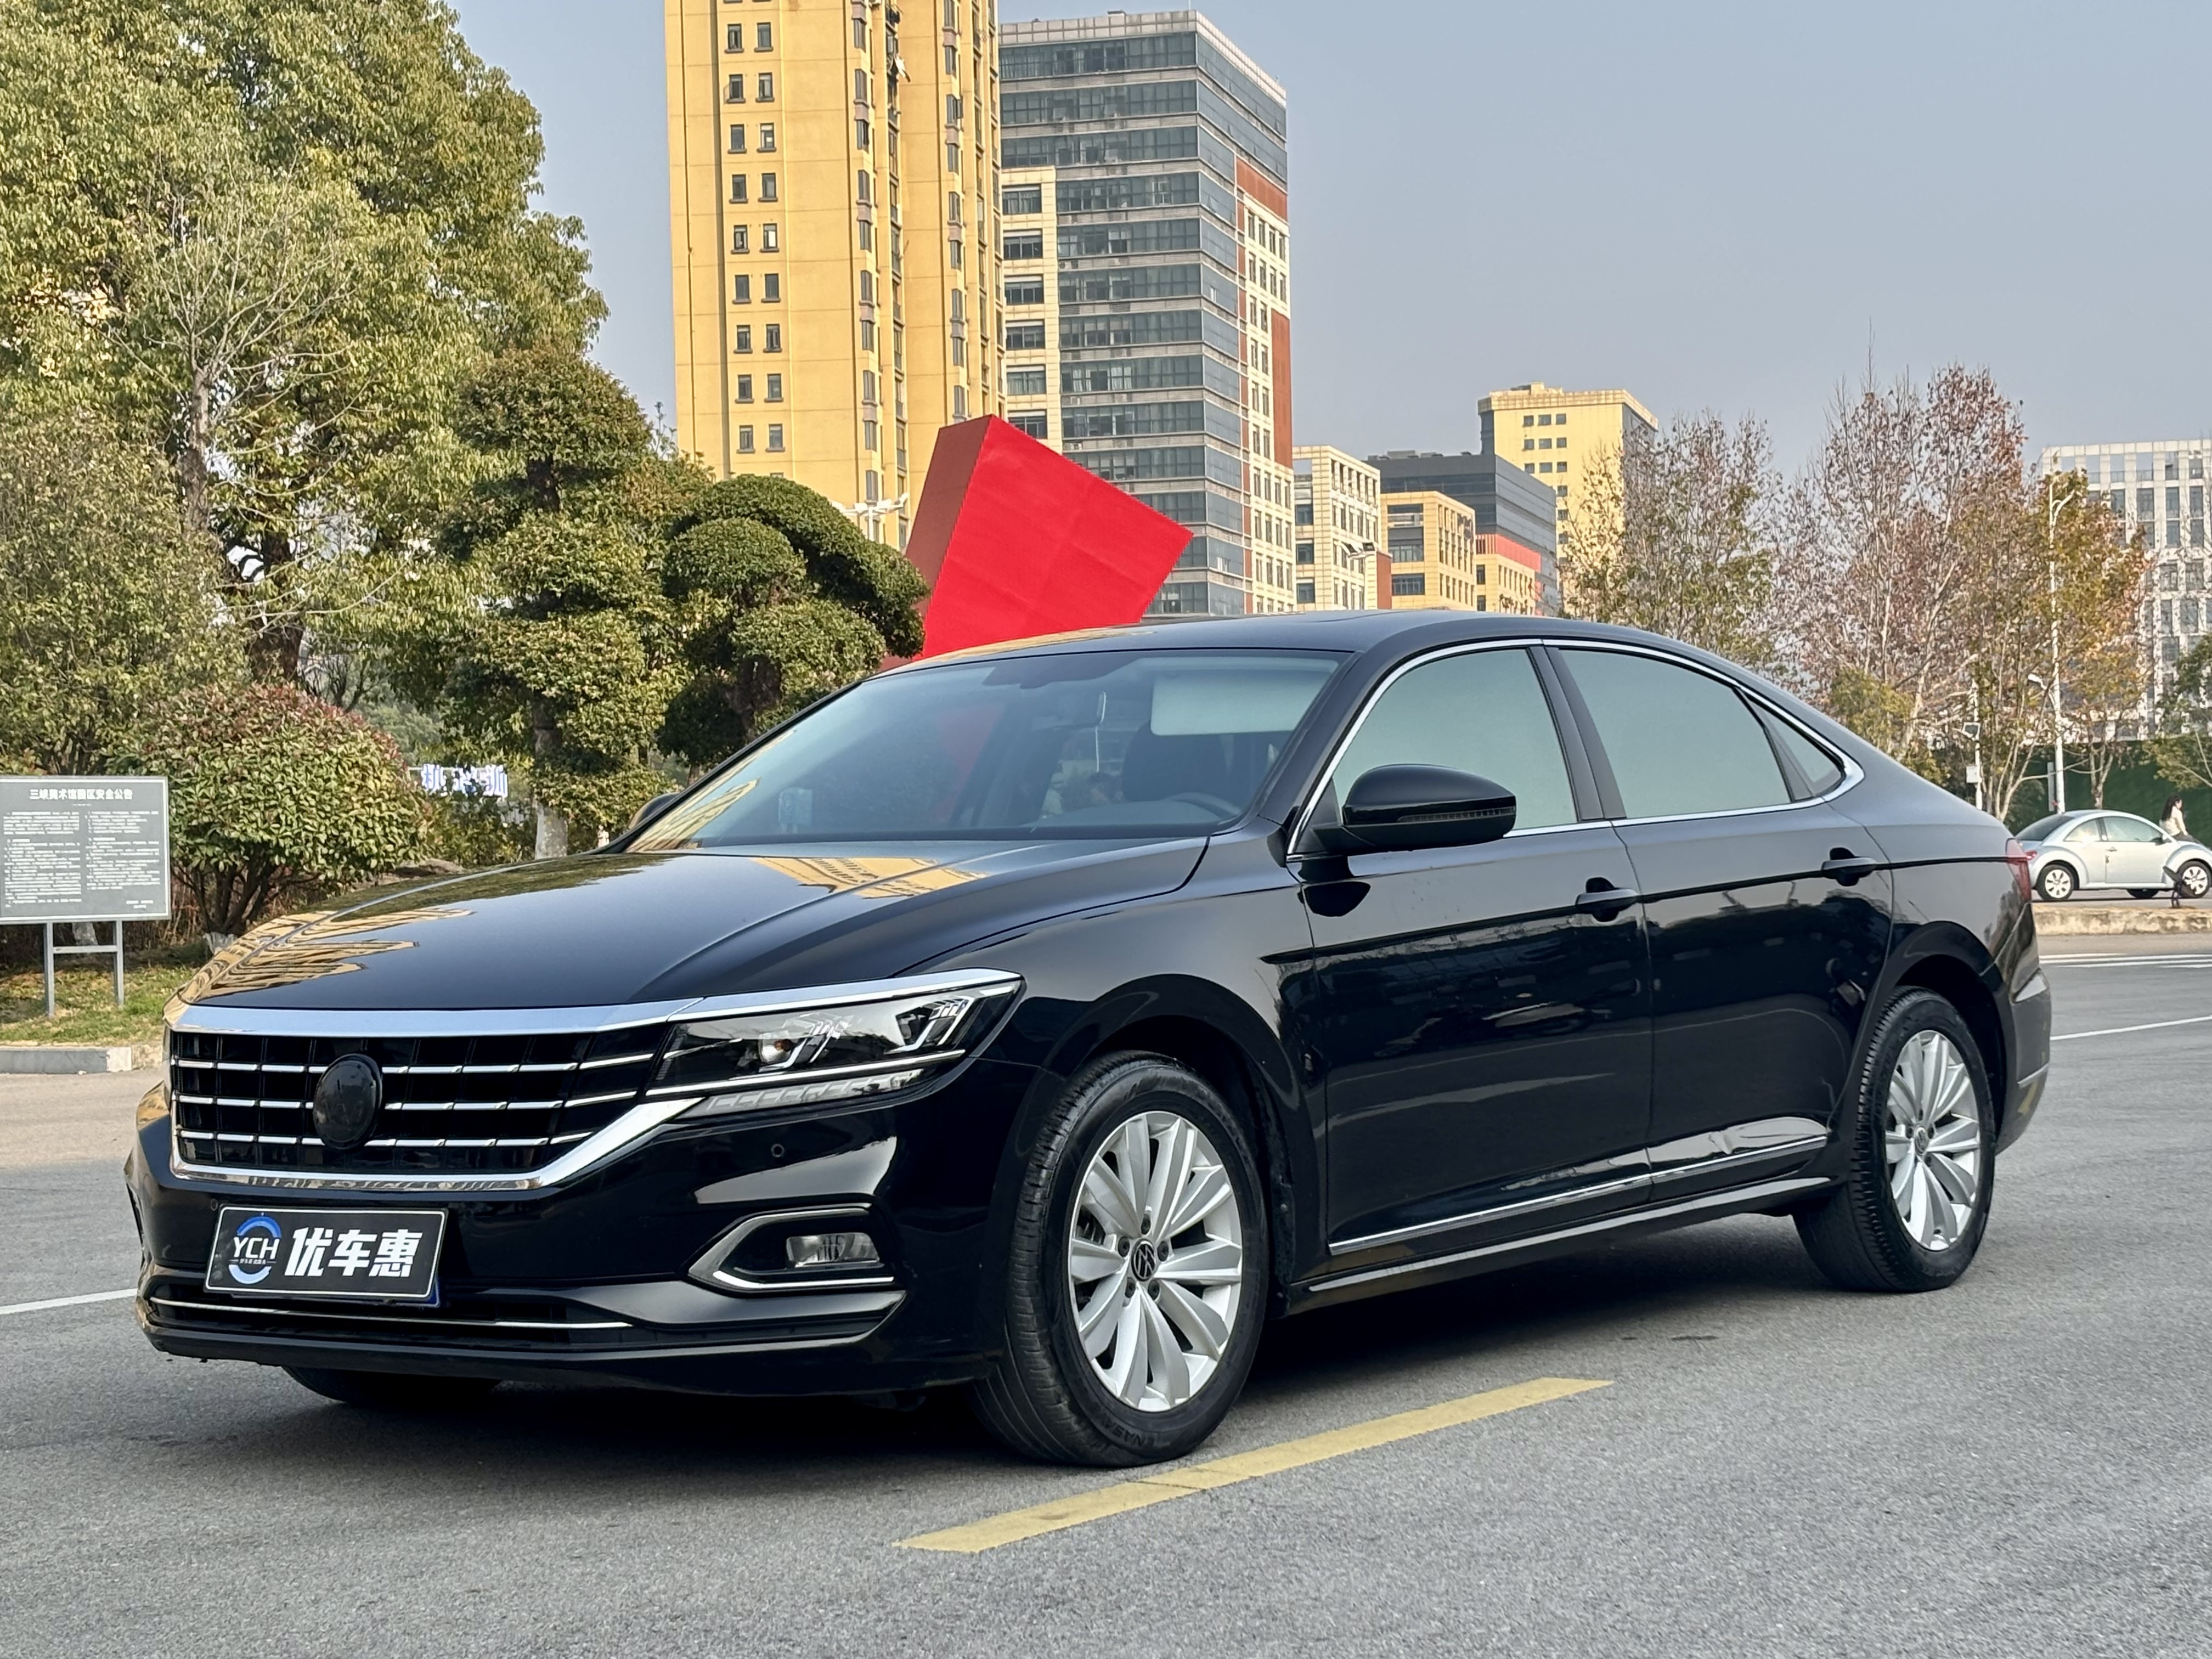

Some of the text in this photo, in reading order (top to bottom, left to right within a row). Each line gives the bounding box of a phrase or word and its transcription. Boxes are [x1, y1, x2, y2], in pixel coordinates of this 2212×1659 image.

[29, 788, 133, 800] 三峡美术馆园区安全公告
[233, 1237, 280, 1260] YCH
[284, 1227, 423, 1278] 优车惠
